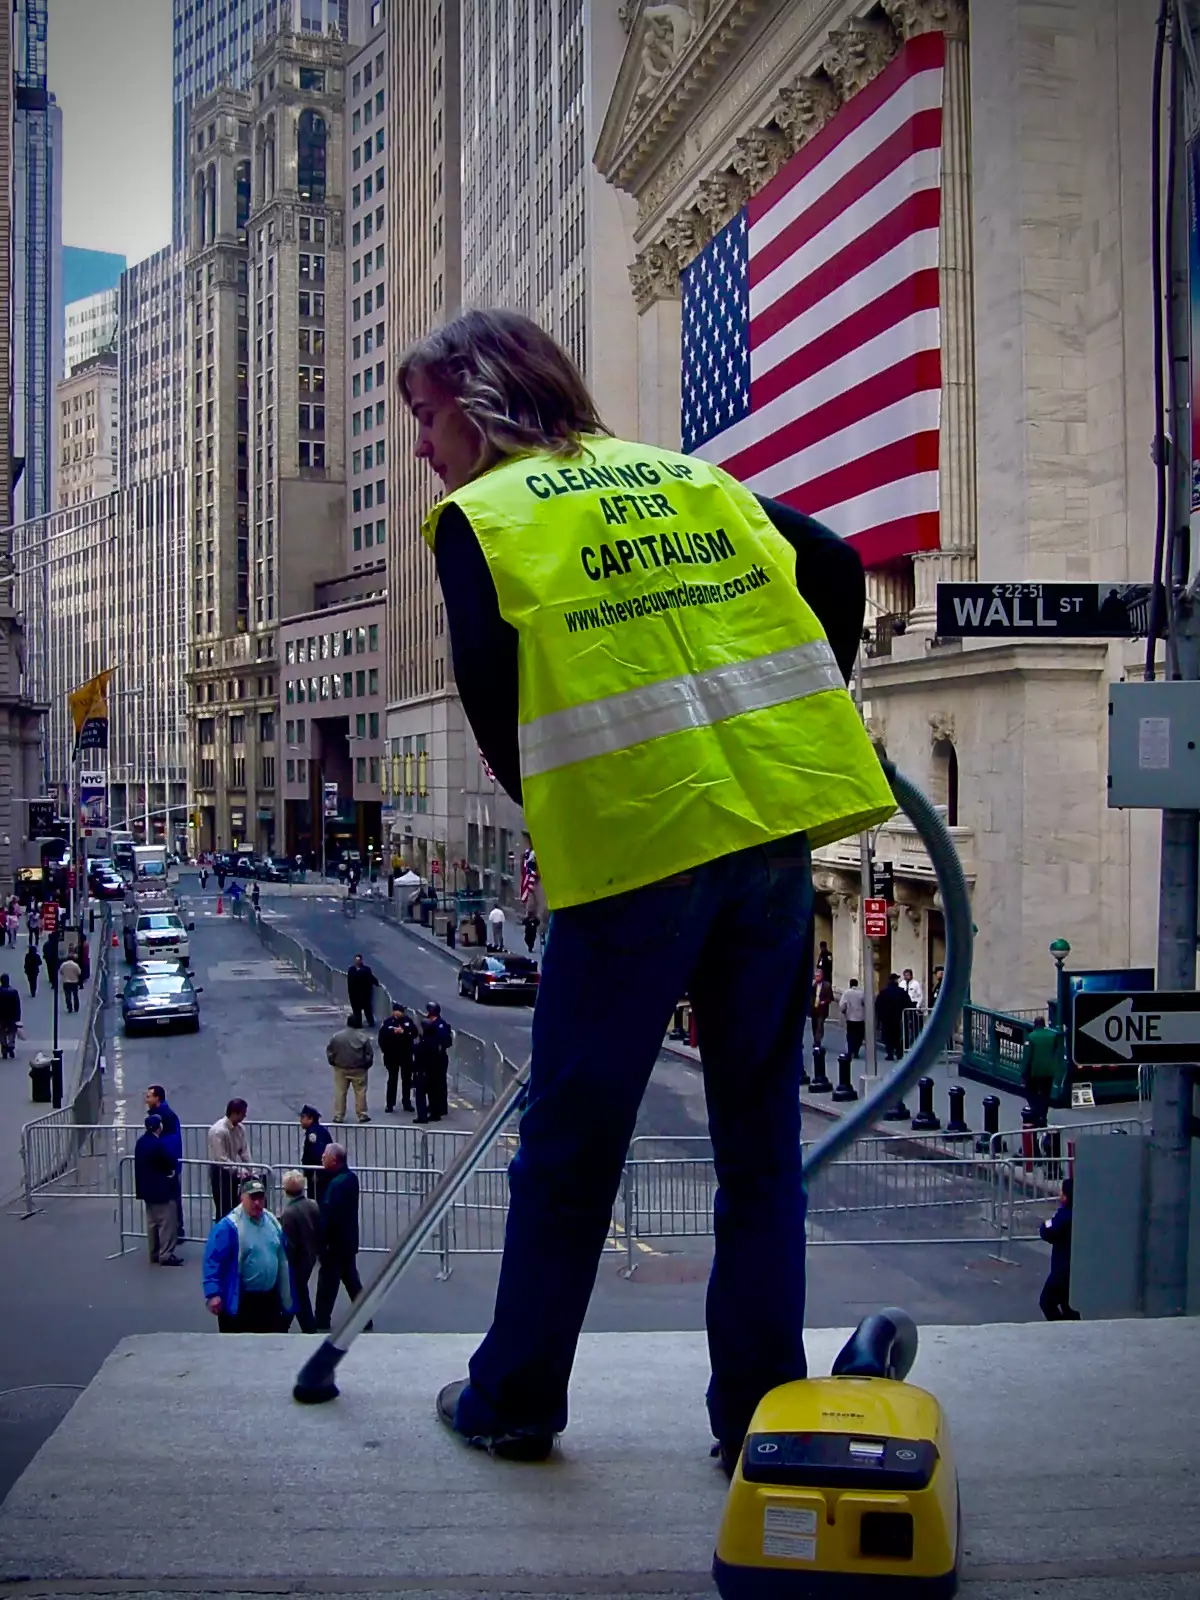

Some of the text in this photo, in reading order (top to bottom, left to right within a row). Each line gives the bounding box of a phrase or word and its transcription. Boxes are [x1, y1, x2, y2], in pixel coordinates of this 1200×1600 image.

[525, 460, 694, 500] CLEANING UP
[599, 493, 678, 526] AFTER
[580, 528, 737, 582] CAPITALISM
[564, 563, 771, 633] www.thevacuumcleaner.co.uk
[1005, 584, 1043, 598] 22-51
[952, 597, 1084, 627] WALL ST
[81, 775, 103, 785] NYC
[1104, 1015, 1162, 1042] ONE
